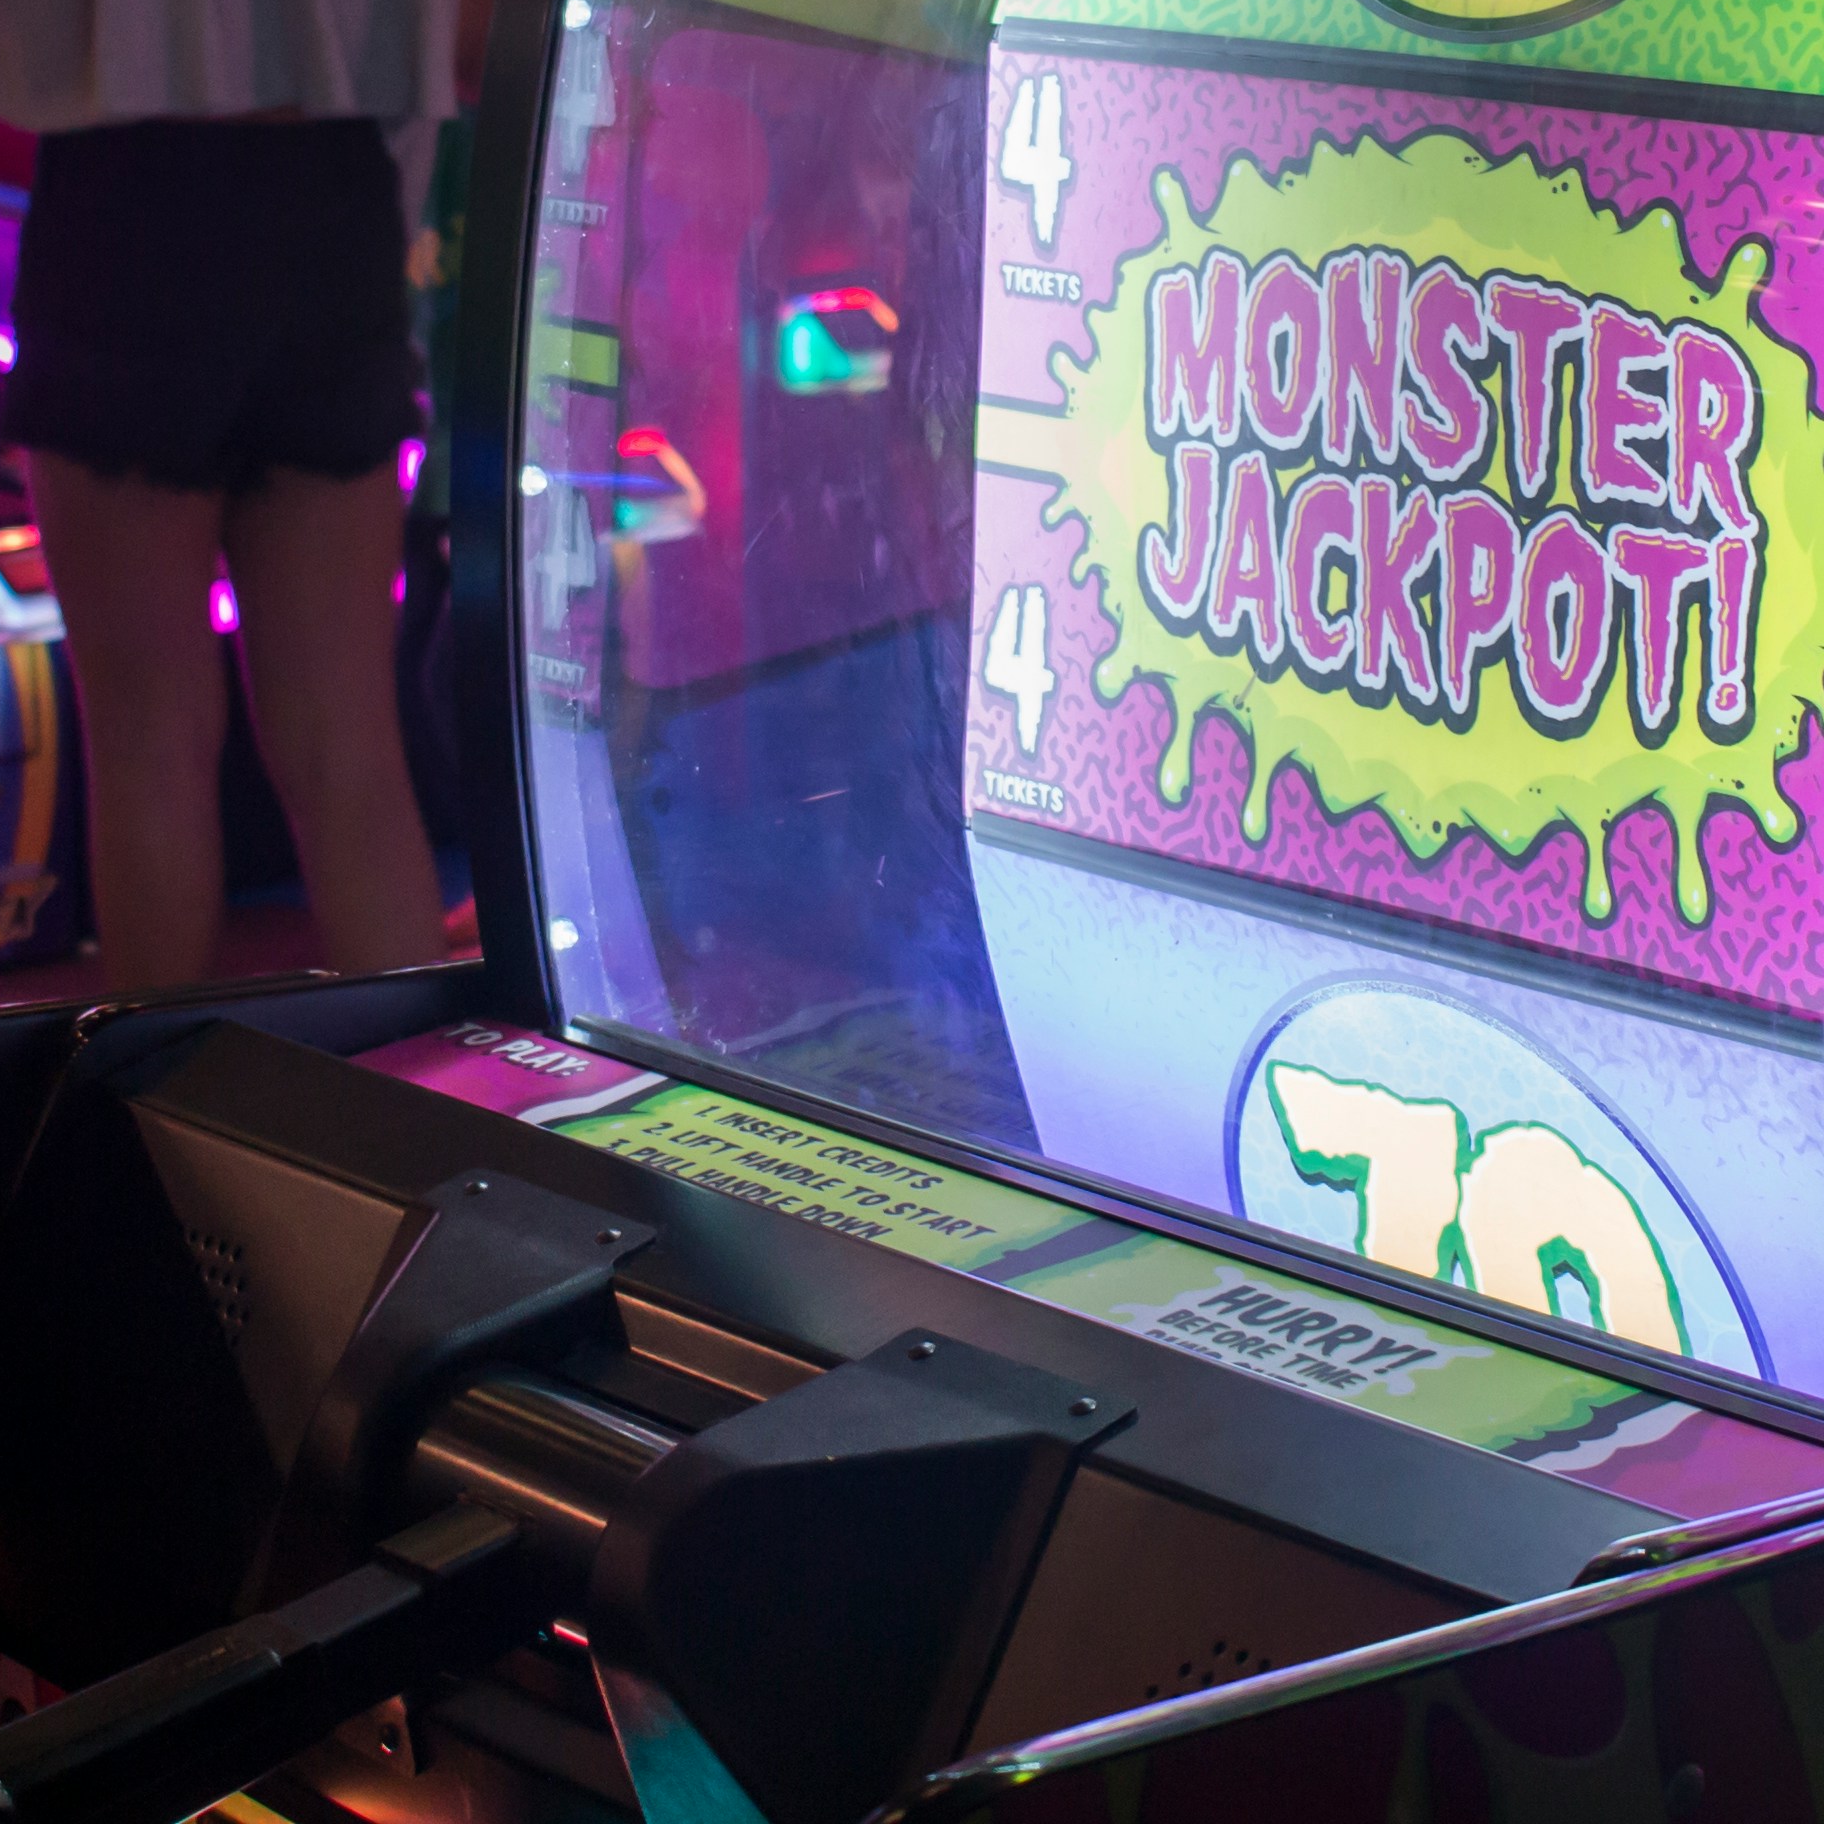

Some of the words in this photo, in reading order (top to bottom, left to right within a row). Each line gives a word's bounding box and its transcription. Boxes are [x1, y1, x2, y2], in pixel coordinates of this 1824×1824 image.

[1001, 73, 1072, 246] 4
[1001, 262, 1084, 302] TICKETS
[1148, 244, 1761, 538] MONSTER
[1141, 444, 1758, 731] JACKPOT!
[984, 585, 1054, 755] 4
[982, 771, 1065, 814] TICKETS
[443, 1021, 504, 1047] TO
[491, 1036, 590, 1079] PLAY:
[628, 1145, 697, 1176] PULL
[692, 1166, 804, 1212] HANDLE
[798, 1202, 895, 1241] DOWN
[642, 1121, 672, 1139] 2.
[669, 1129, 746, 1161] LIFT
[737, 1148, 846, 1193] HANDLE
[848, 1183, 892, 1208] TO
[883, 1200, 998, 1241] START
[694, 1105, 722, 1121] 1.
[713, 1111, 812, 1151] INSERT
[817, 1144, 945, 1192] CREDITS
[1266, 1058, 1693, 1360] 70
[1157, 1308, 1286, 1360] BEFORE
[1281, 1352, 1369, 1390] TIME
[1197, 1284, 1437, 1374] HURRY!
